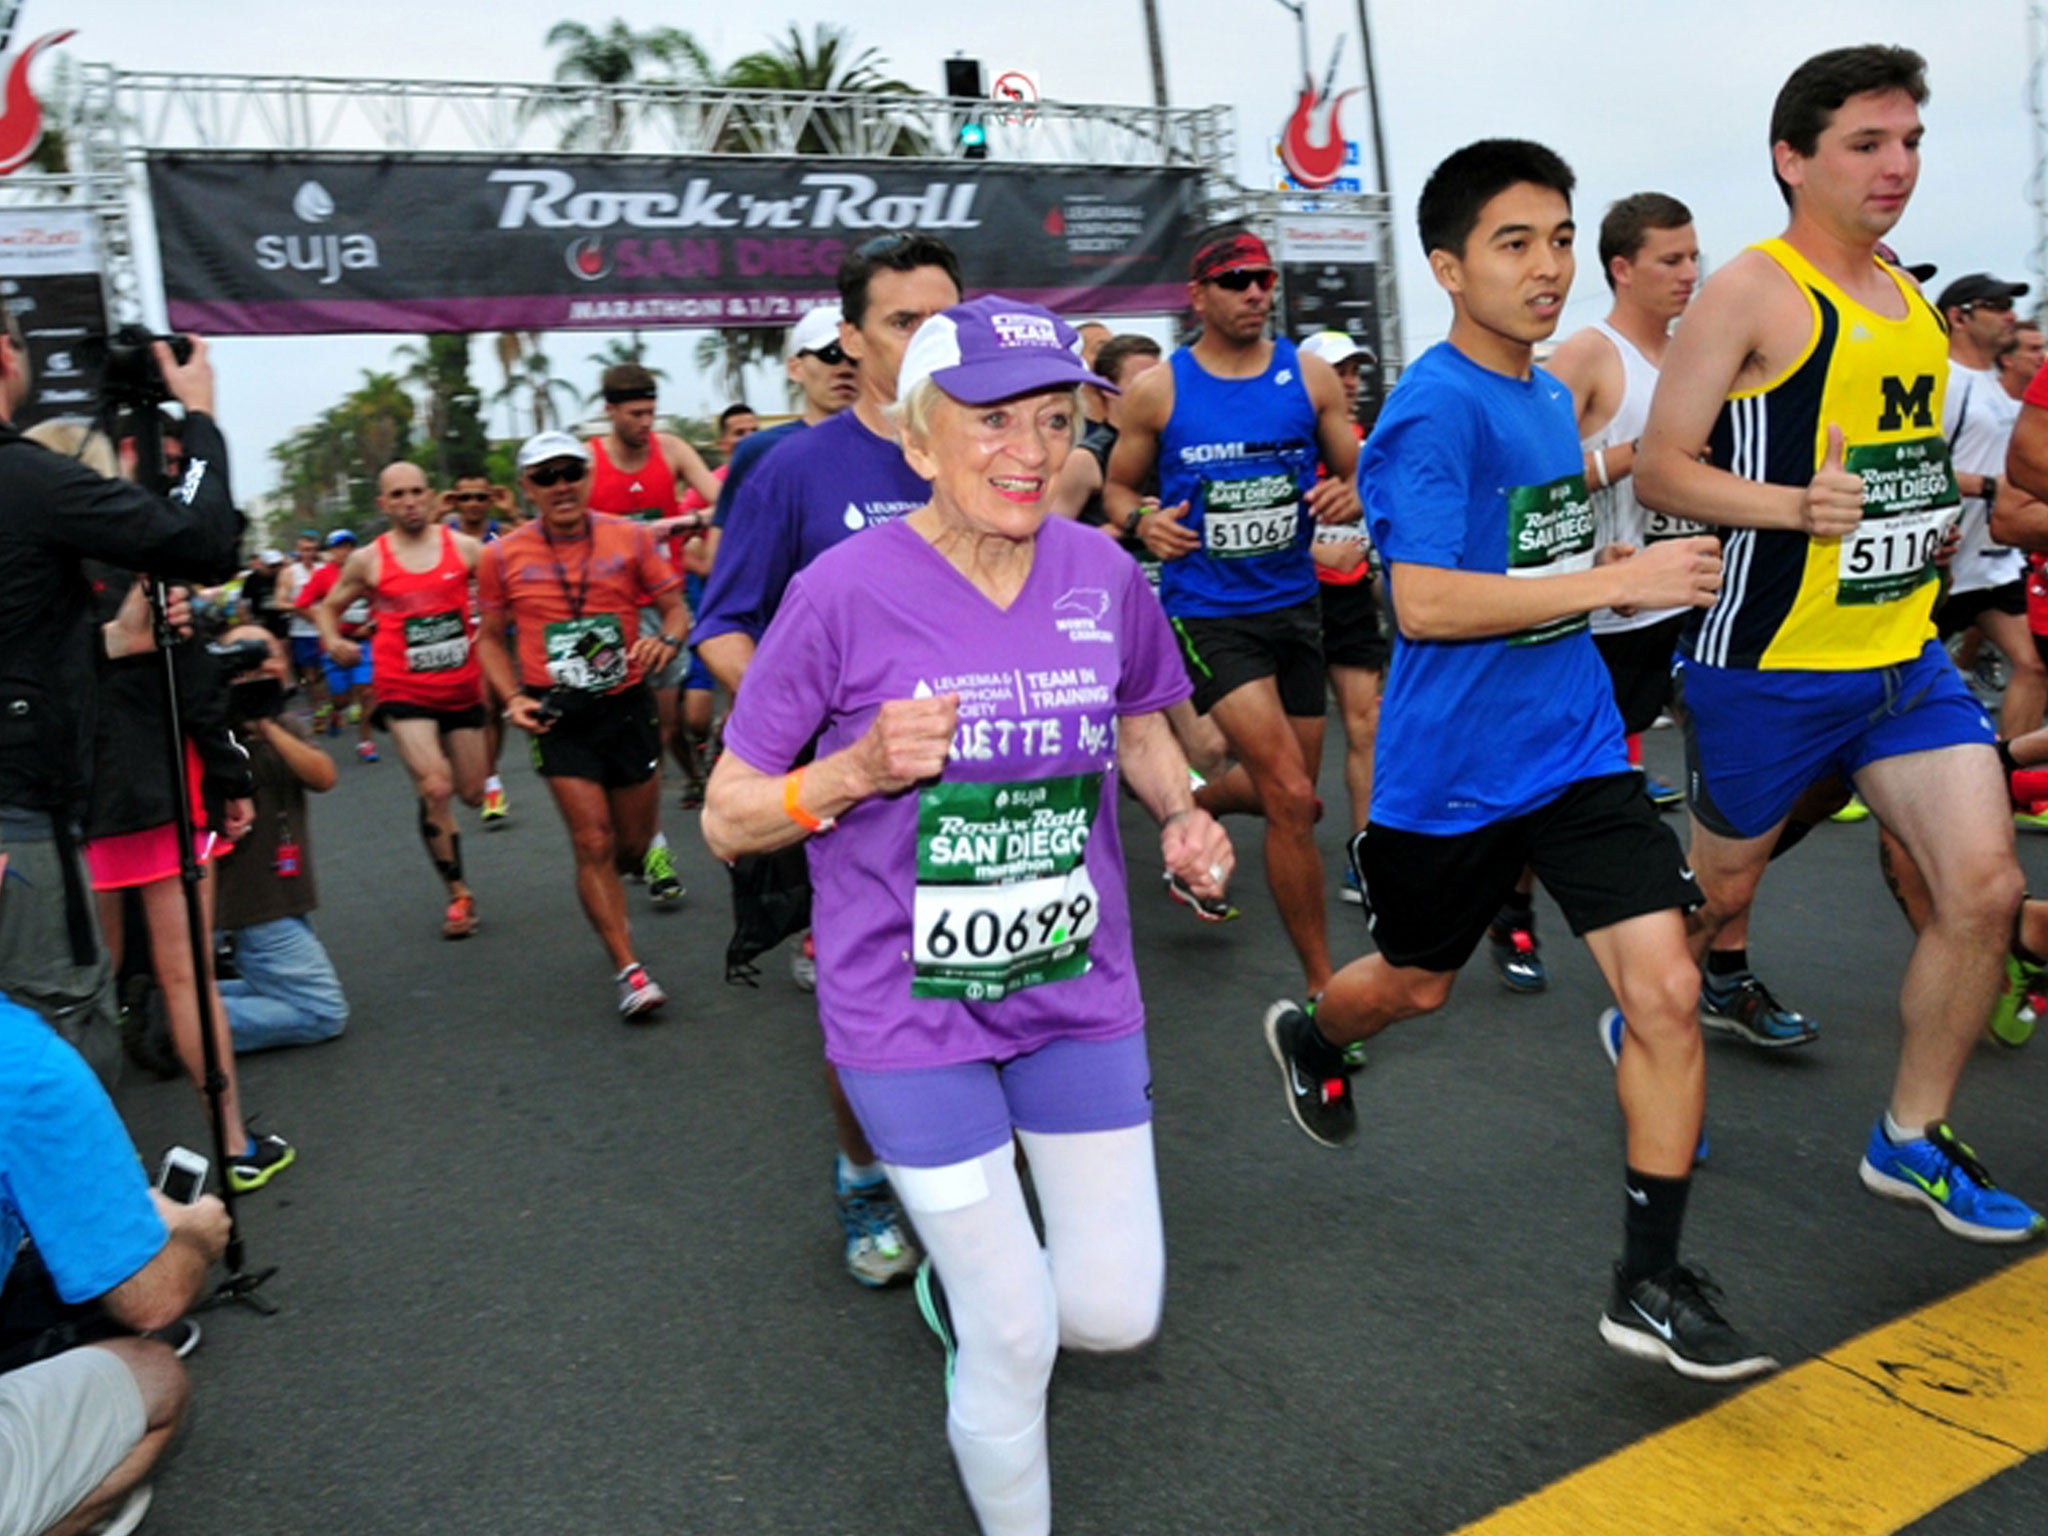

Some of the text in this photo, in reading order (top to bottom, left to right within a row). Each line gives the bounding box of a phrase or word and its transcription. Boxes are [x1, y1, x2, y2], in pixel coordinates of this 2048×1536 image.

[255, 233, 379, 284] suja
[615, 237, 848, 278] SAN DIEG
[569, 299, 723, 321] MARATHON
[1877, 374, 1935, 431] M
[1901, 475, 1949, 500] DIEGO
[1213, 516, 1294, 547] 51067
[1848, 528, 1938, 574] 5110
[1027, 672, 1078, 690] TEAM
[1031, 684, 1110, 710] TRAINING
[929, 825, 1090, 866] SAN DIEGO
[975, 857, 1054, 880] marathon
[926, 892, 1093, 959] 60699
